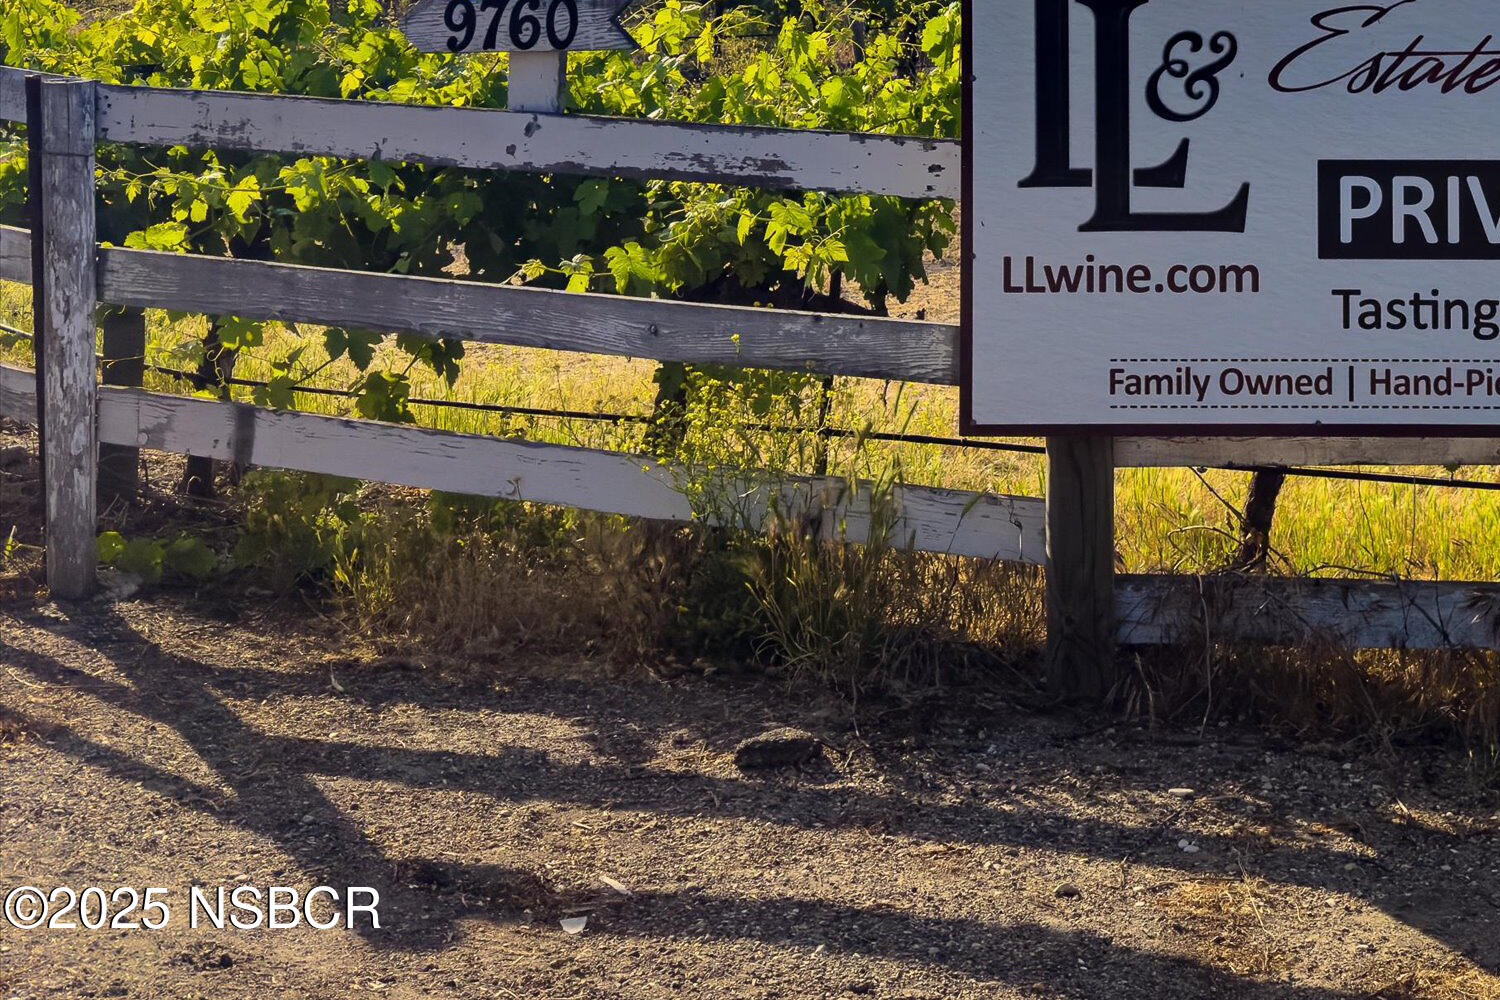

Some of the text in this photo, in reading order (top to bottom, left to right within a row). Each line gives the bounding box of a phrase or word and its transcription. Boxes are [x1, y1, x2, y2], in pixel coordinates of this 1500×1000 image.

[1002, 254, 1260, 293] LLwine.com
[1331, 287, 1500, 341] Tasting
[1108, 366, 1211, 402] Family
[1219, 366, 1333, 396] Owned
